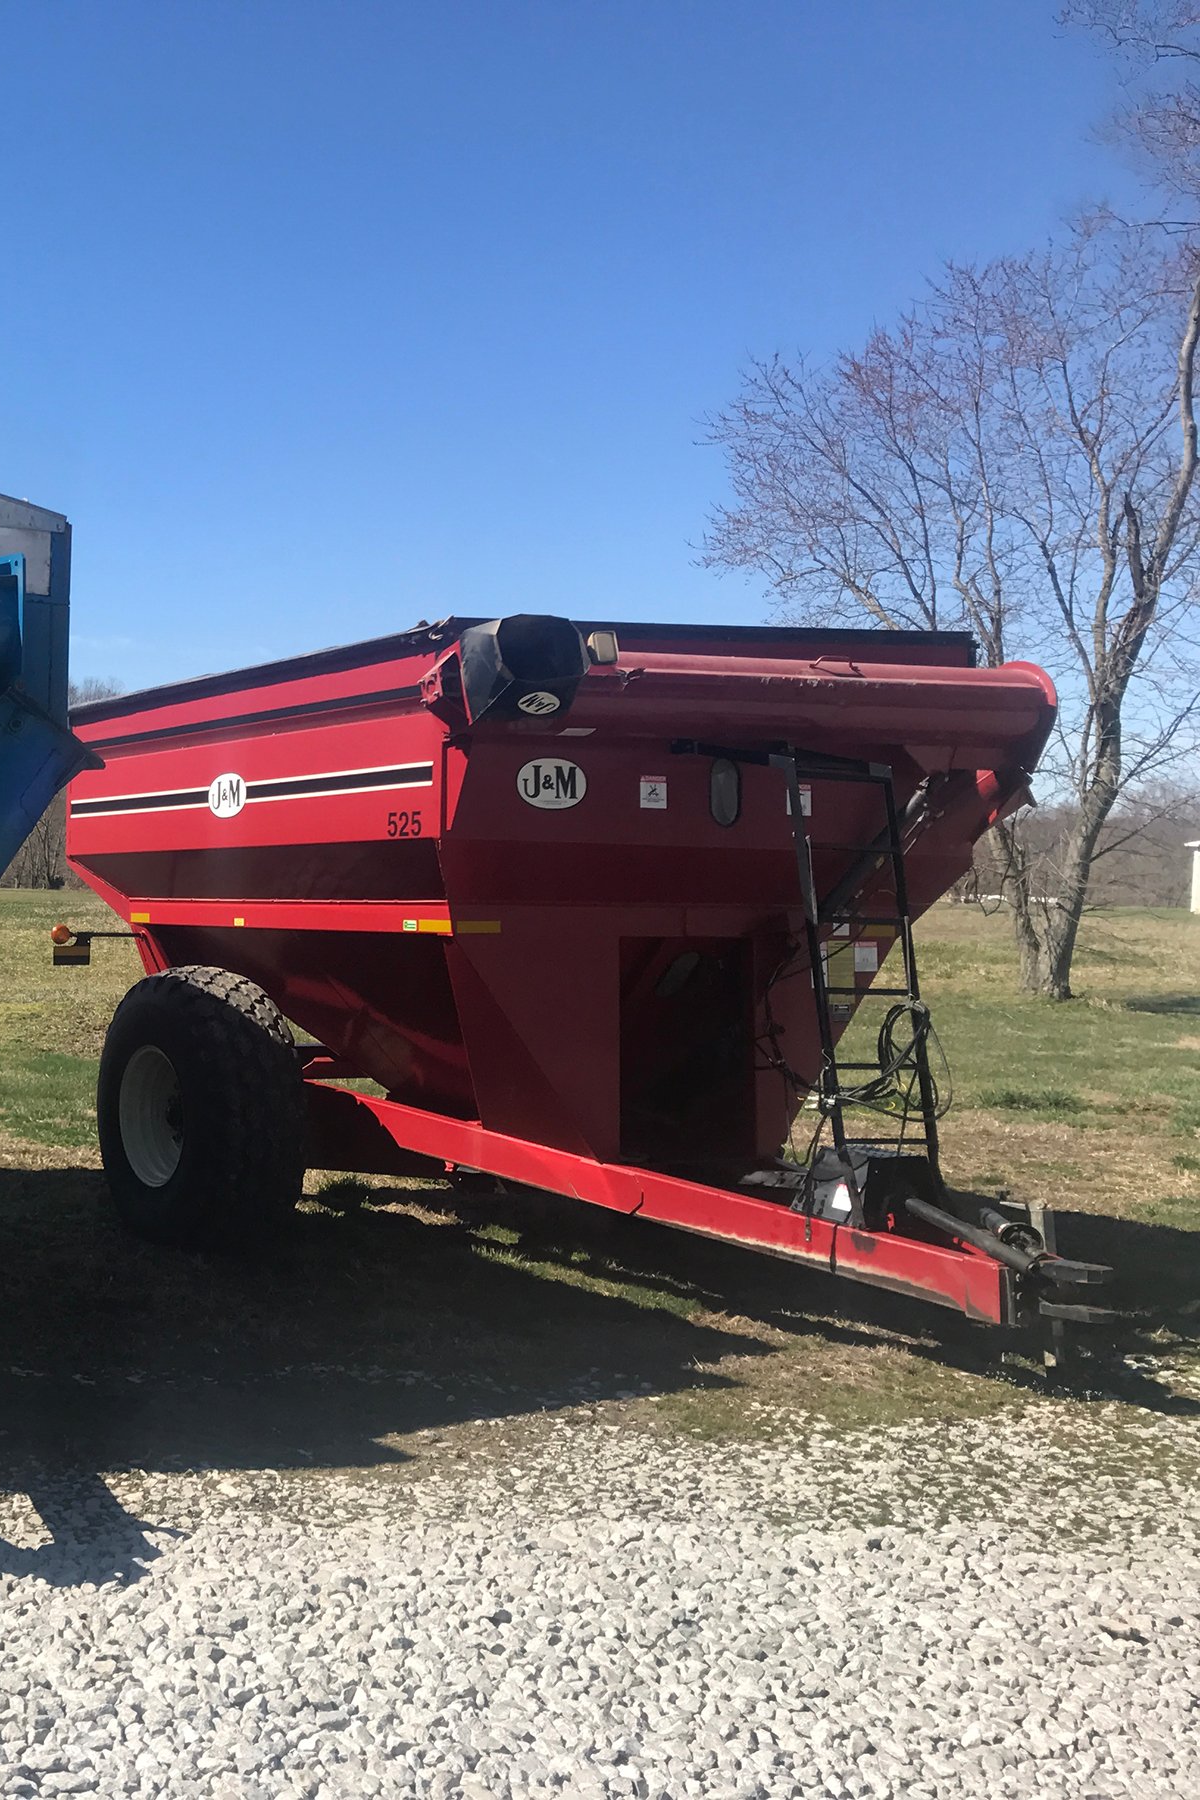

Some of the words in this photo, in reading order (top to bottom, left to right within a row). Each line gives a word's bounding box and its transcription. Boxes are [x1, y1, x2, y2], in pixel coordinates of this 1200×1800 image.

[211, 778, 241, 810] J&M
[522, 764, 578, 799] J&M
[387, 811, 422, 837] 525
